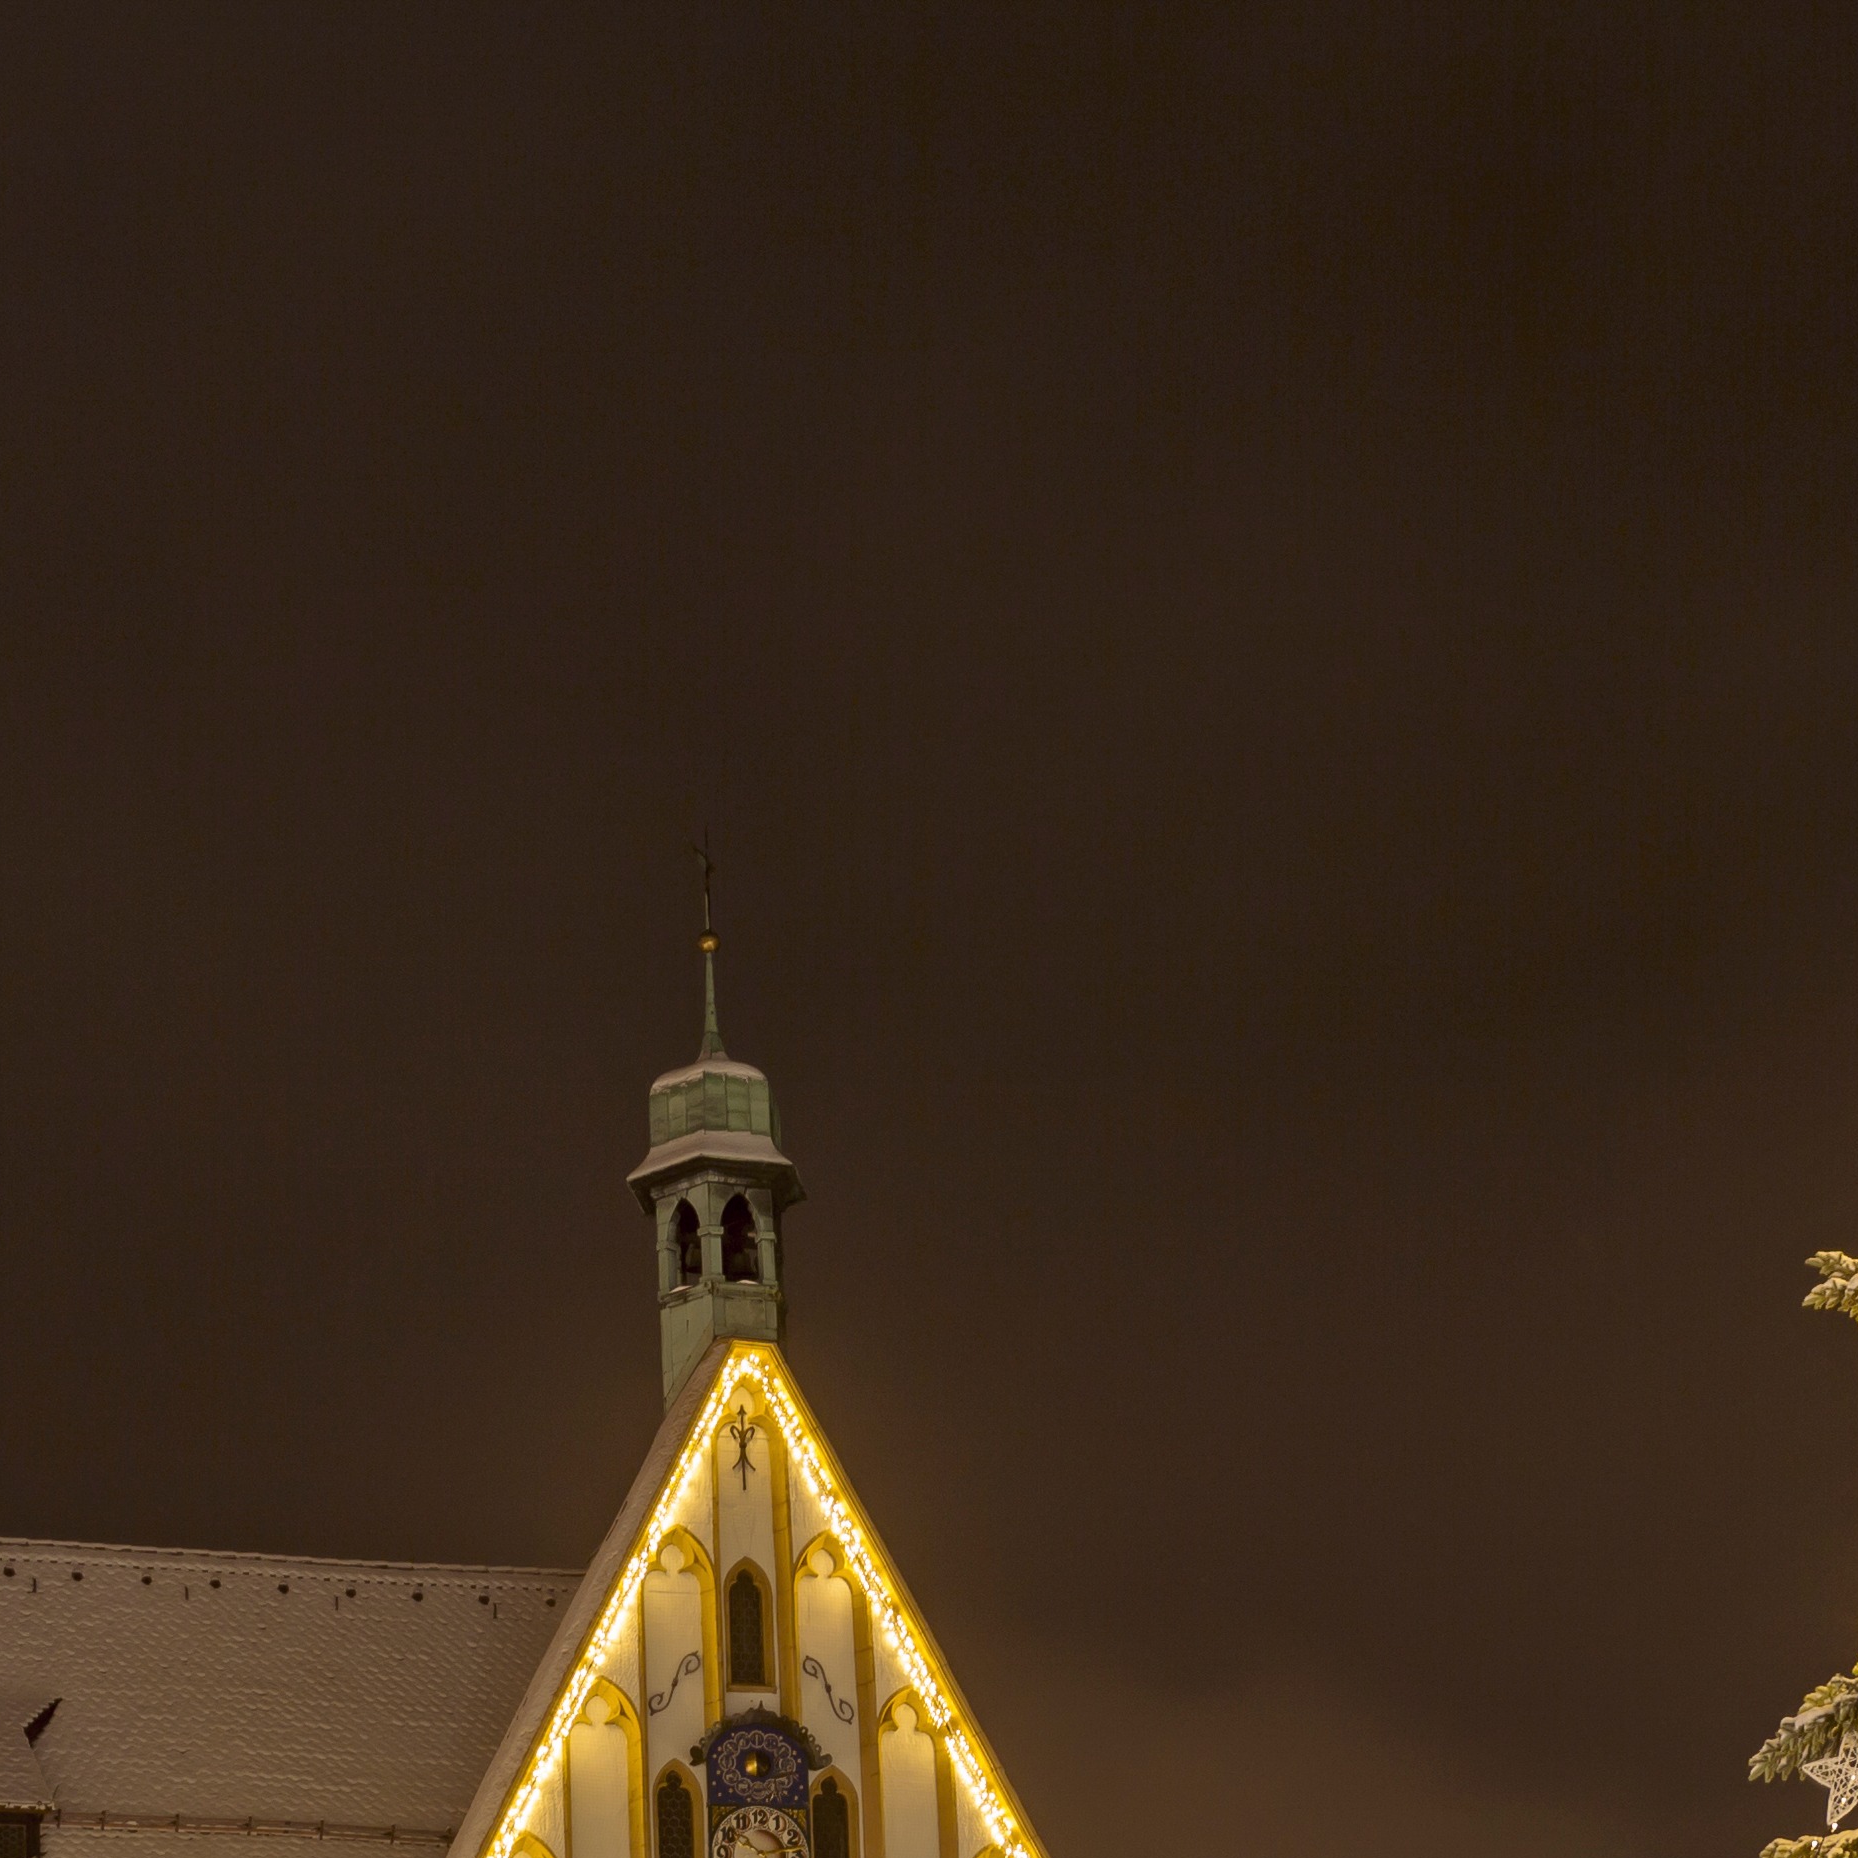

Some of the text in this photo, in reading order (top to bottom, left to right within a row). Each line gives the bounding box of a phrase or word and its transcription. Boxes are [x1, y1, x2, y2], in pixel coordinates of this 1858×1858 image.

[734, 1814, 747, 1830] 11
[752, 1809, 768, 1825] 12
[773, 1815, 781, 1830] 1
[720, 1826, 736, 1843] 10
[787, 1829, 799, 1846] 2
